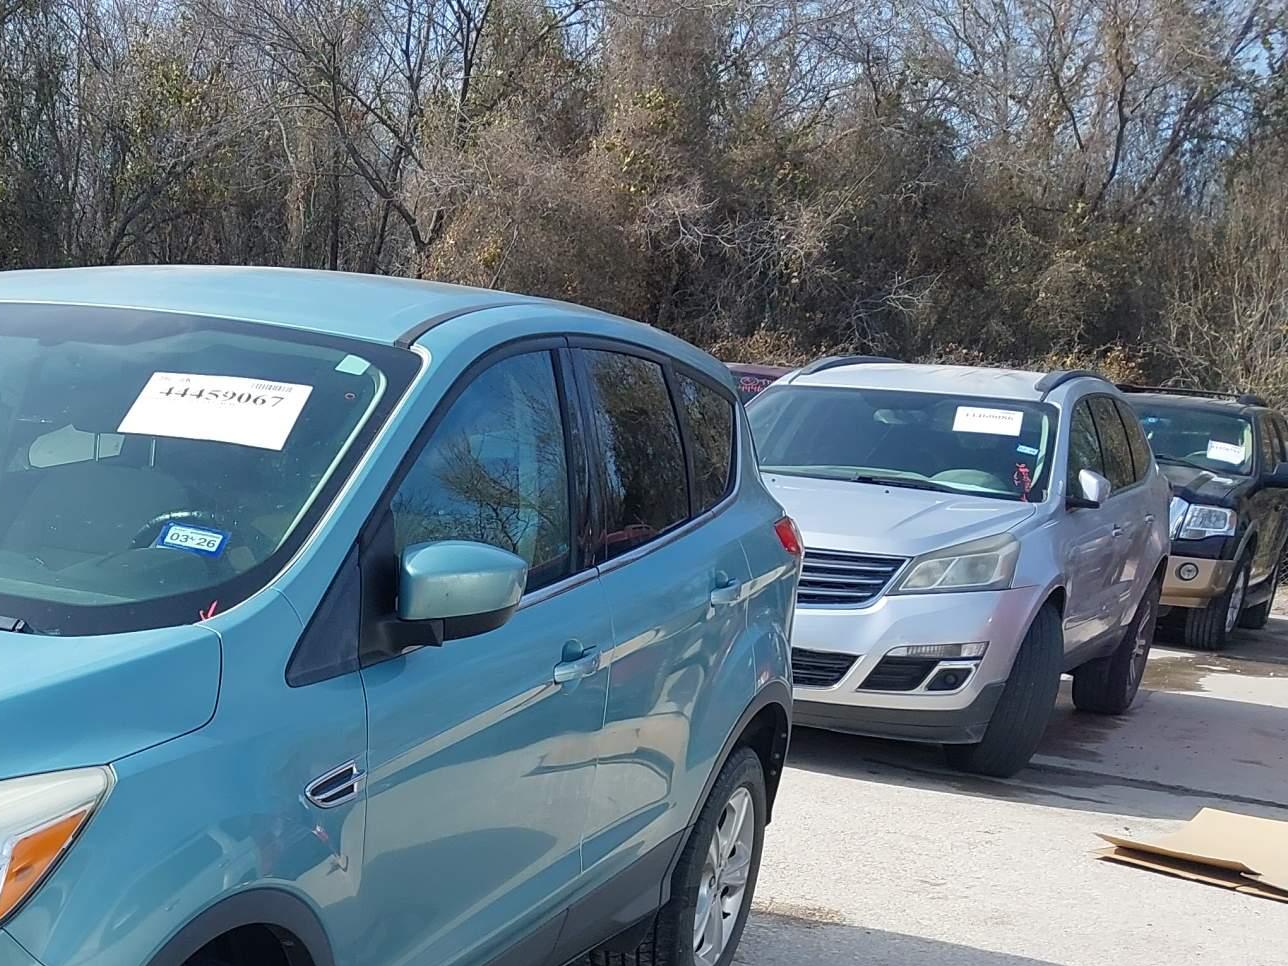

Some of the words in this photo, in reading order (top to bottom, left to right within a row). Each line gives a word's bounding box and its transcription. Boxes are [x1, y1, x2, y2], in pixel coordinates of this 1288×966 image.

[159, 386, 286, 408] 44459067
[169, 532, 190, 543] 03
[195, 537, 217, 549] 26
